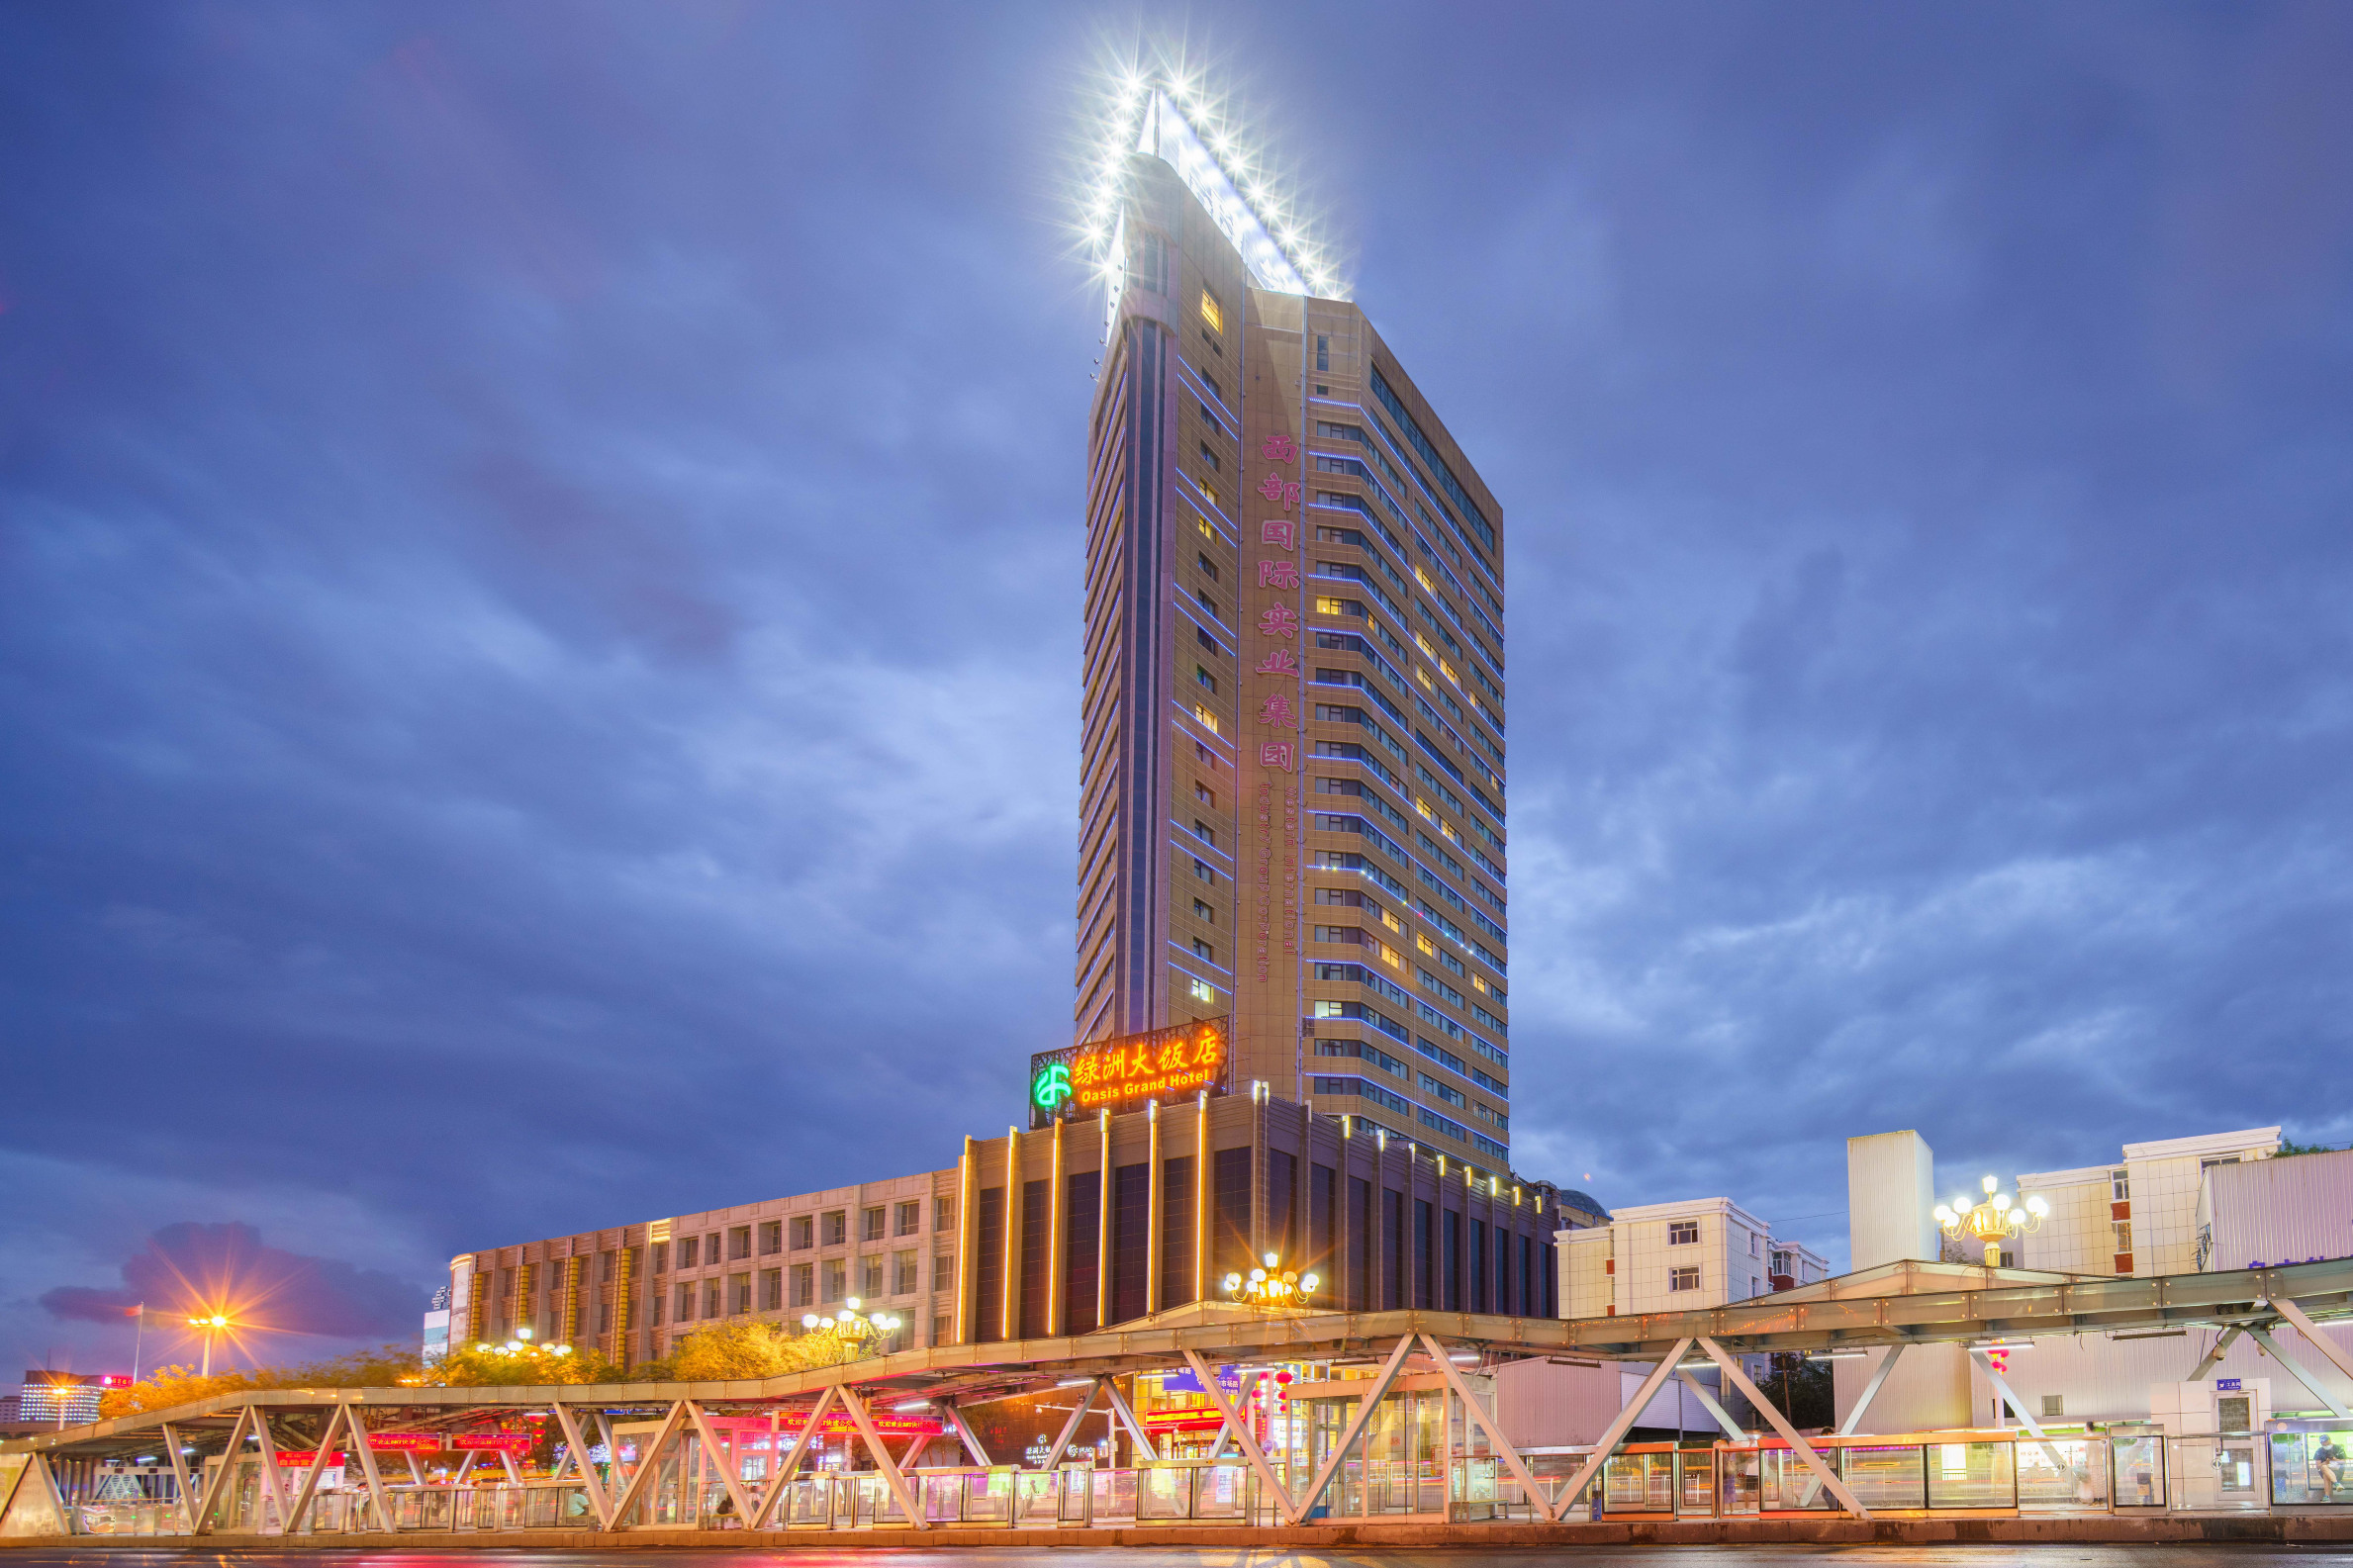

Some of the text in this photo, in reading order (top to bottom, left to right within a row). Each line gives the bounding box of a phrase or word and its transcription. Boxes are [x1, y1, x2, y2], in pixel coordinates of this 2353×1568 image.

[1256, 435, 1300, 773] 西部国际实业集团
[1258, 784, 1271, 982] Industry Group Corporation
[1284, 785, 1296, 955] Western International
[1075, 1029, 1219, 1085] 绿洲大饭店
[1082, 1069, 1209, 1103] Oasis Grand Hotel
